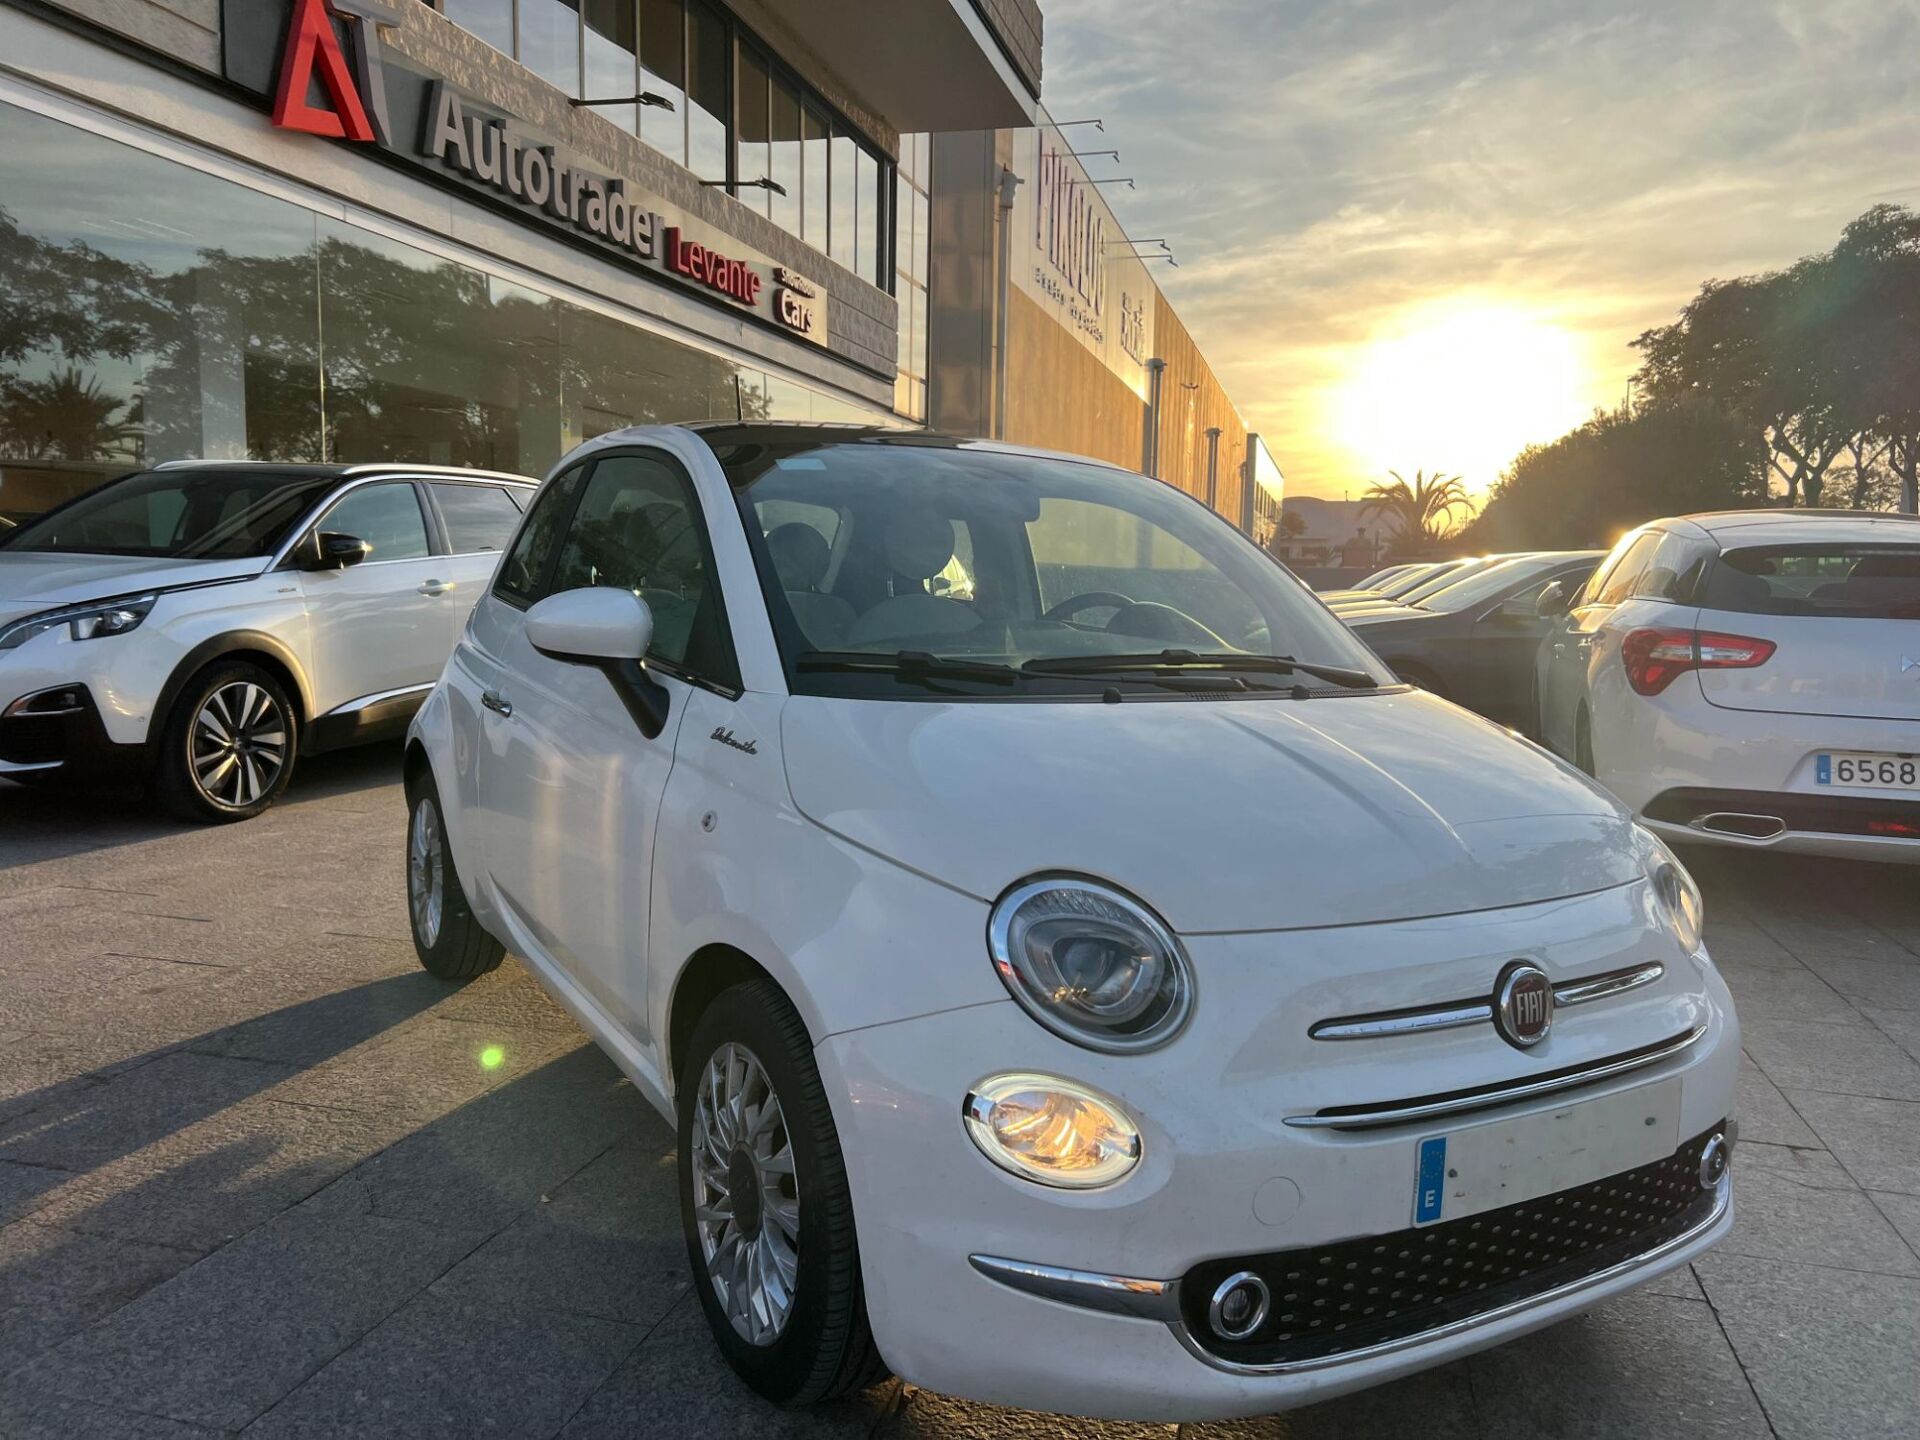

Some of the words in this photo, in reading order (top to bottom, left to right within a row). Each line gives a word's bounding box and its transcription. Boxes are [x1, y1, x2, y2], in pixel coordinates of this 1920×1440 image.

[427, 80, 666, 261] Autotrader
[667, 226, 762, 306] Levante
[774, 288, 813, 333] Cars
[1837, 759, 1916, 785] 6568
[1516, 989, 1544, 1025] FIAT
[1424, 1189, 1435, 1208] E
